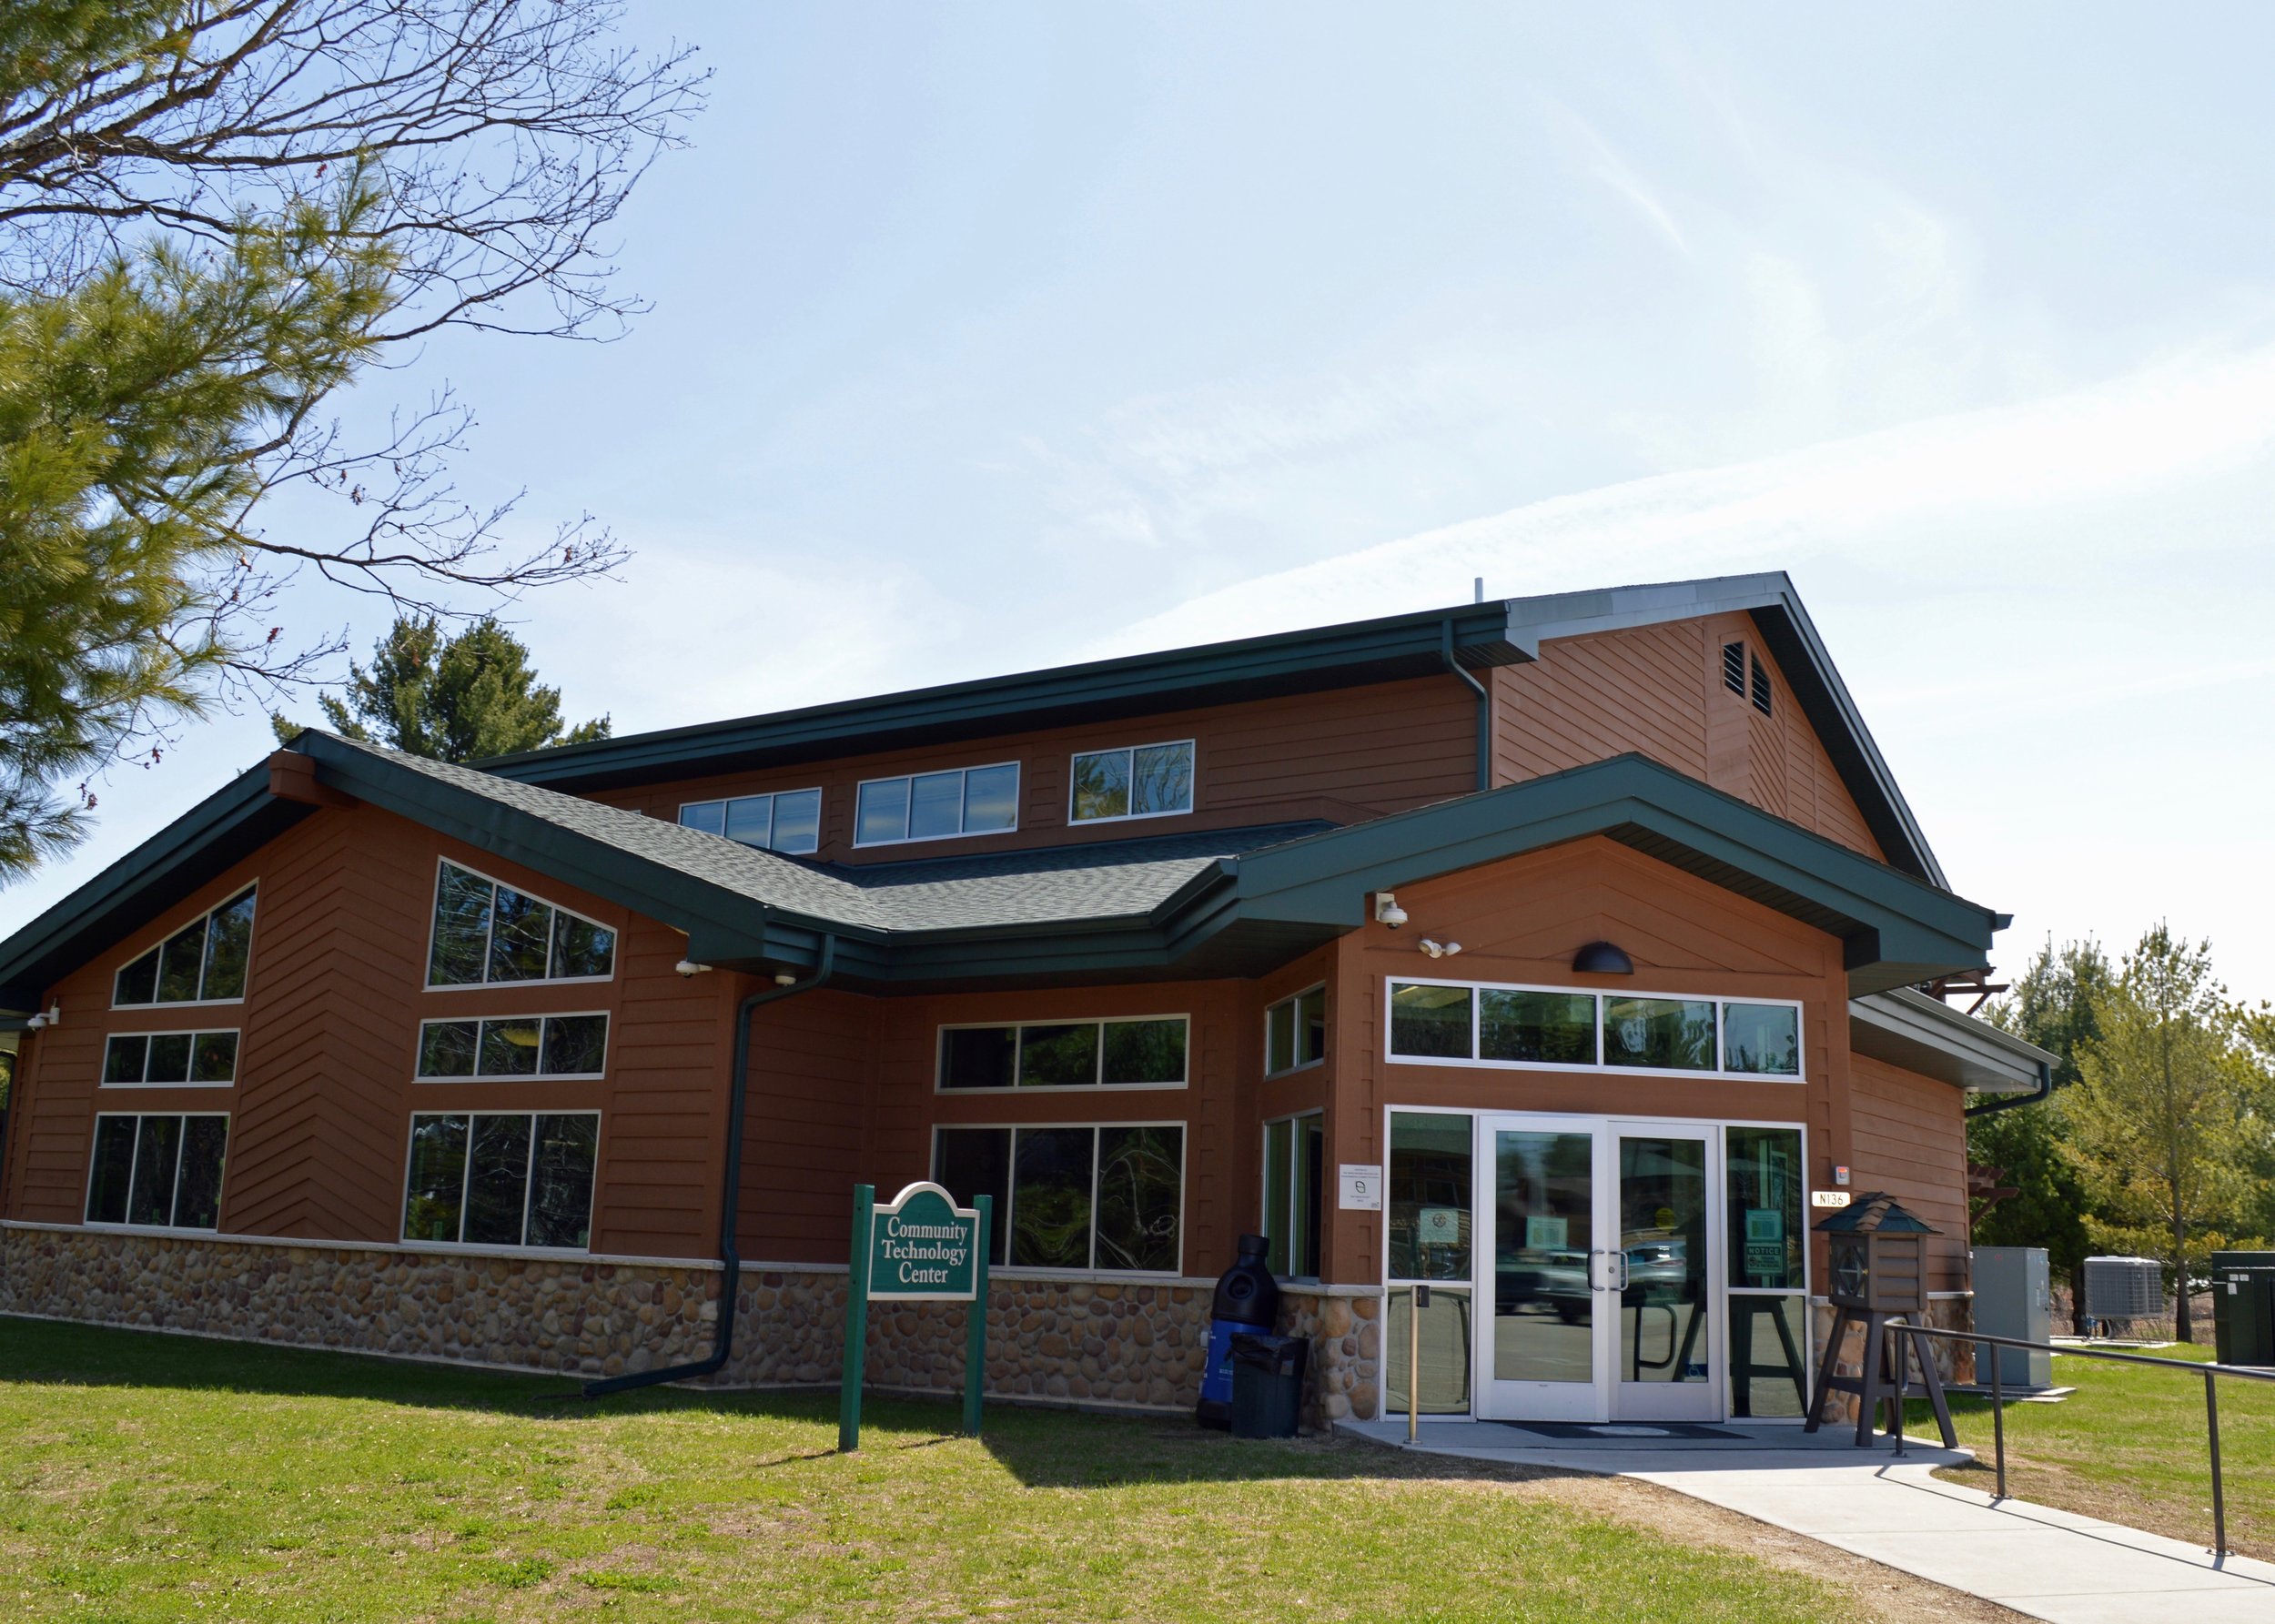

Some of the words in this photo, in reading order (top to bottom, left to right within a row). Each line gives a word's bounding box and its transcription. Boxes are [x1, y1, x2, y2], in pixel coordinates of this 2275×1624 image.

[1820, 1194, 1844, 1205] N136
[887, 1216, 968, 1246] Community
[881, 1239, 966, 1266] Technology
[899, 1261, 948, 1283] Center
